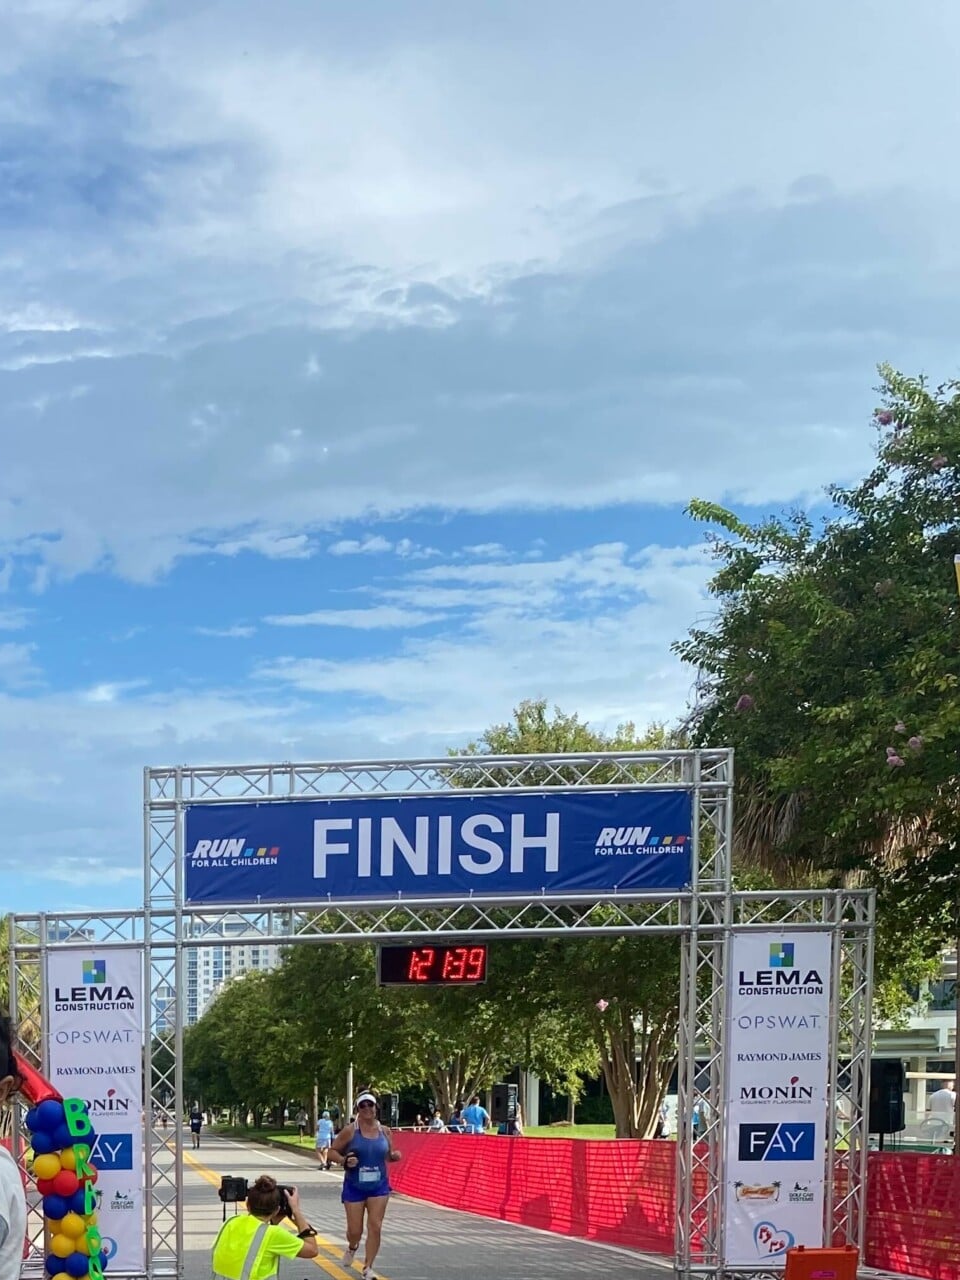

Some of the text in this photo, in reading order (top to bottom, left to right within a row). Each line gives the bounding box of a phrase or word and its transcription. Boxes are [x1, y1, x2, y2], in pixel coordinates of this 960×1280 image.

[595, 827, 651, 847] RUN
[192, 838, 246, 858] RUN
[313, 812, 560, 878] FINISH
[595, 846, 684, 856] FOR ALL CHILDREN
[191, 857, 278, 868] FOR ALL CHILDREN
[738, 970, 823, 986] LEMA
[55, 986, 135, 1002] LEMA
[738, 986, 823, 996] CONSTRUCTION
[55, 1002, 135, 1012] CONSTRUCTION
[737, 1052, 821, 1062] RAYMOND JAMES
[56, 1065, 136, 1075] RAYMOND JAMES
[740, 1086, 813, 1099] MONIN
[750, 1131, 805, 1153] FAY
[87, 1141, 123, 1163] AY
